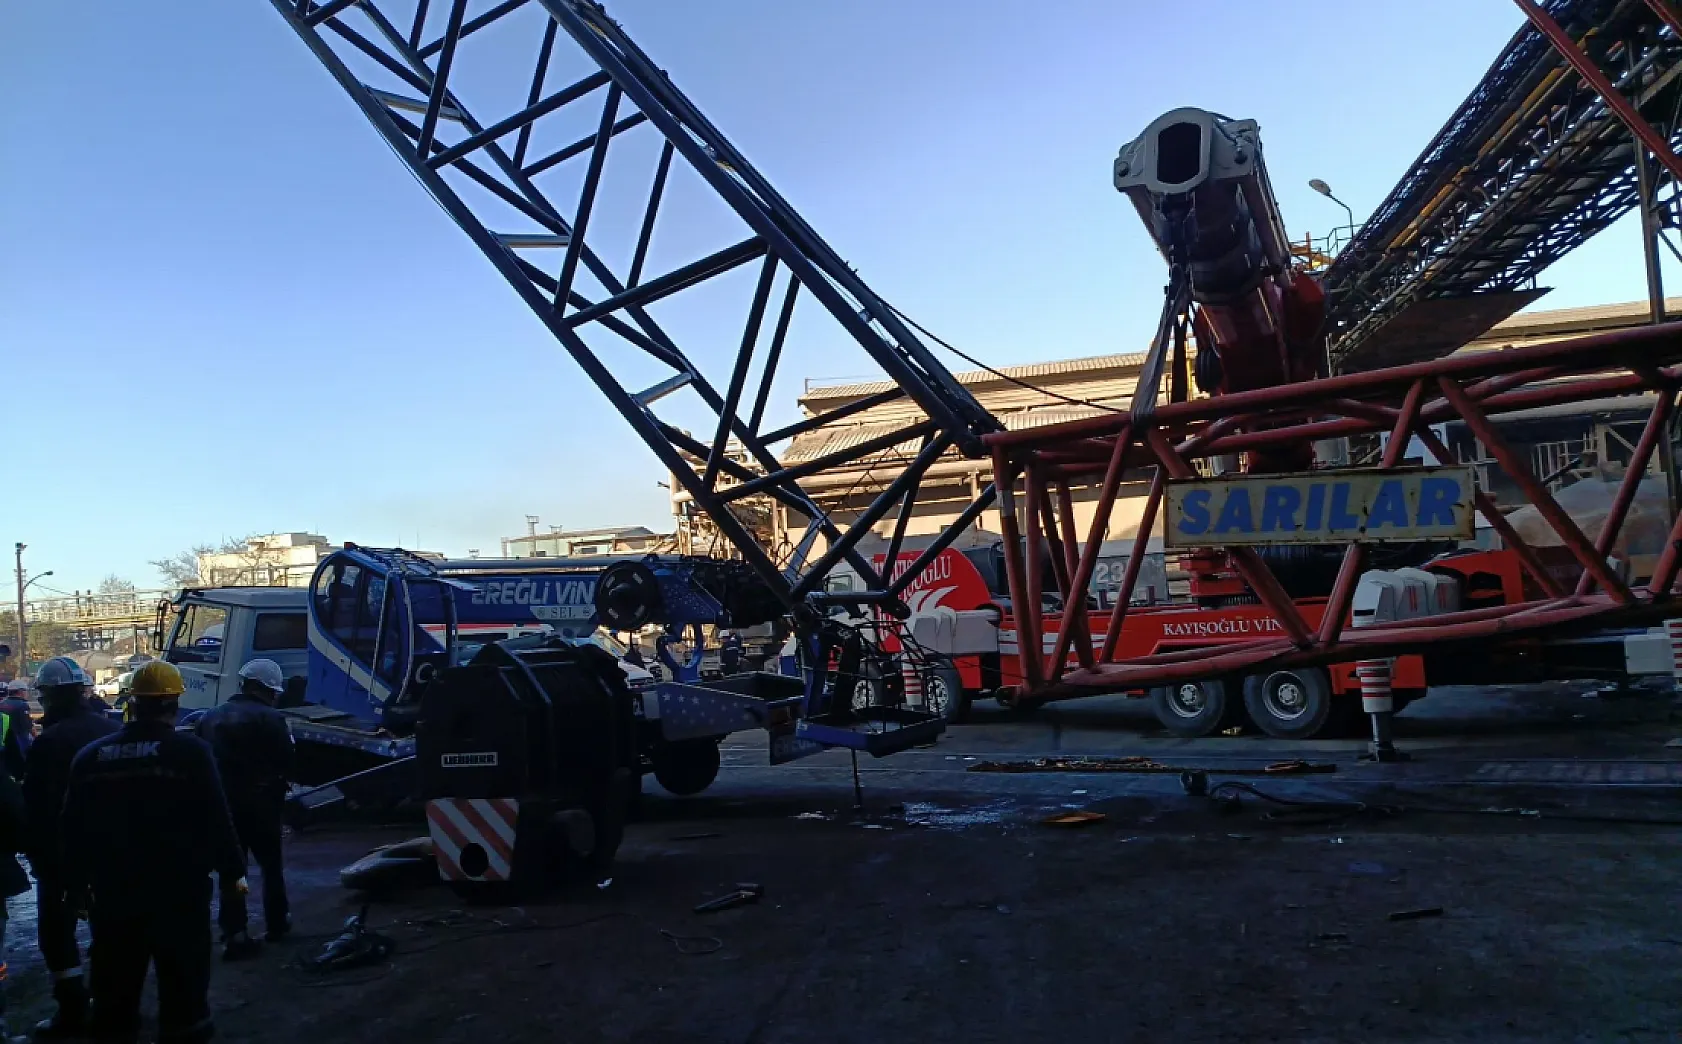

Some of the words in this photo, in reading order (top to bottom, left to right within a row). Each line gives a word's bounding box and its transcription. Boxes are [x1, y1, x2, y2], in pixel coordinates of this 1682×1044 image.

[1178, 478, 1461, 534] SARILAR
[550, 606, 576, 619] SEL
[1163, 617, 1250, 636] KAYIŞOĞLU
